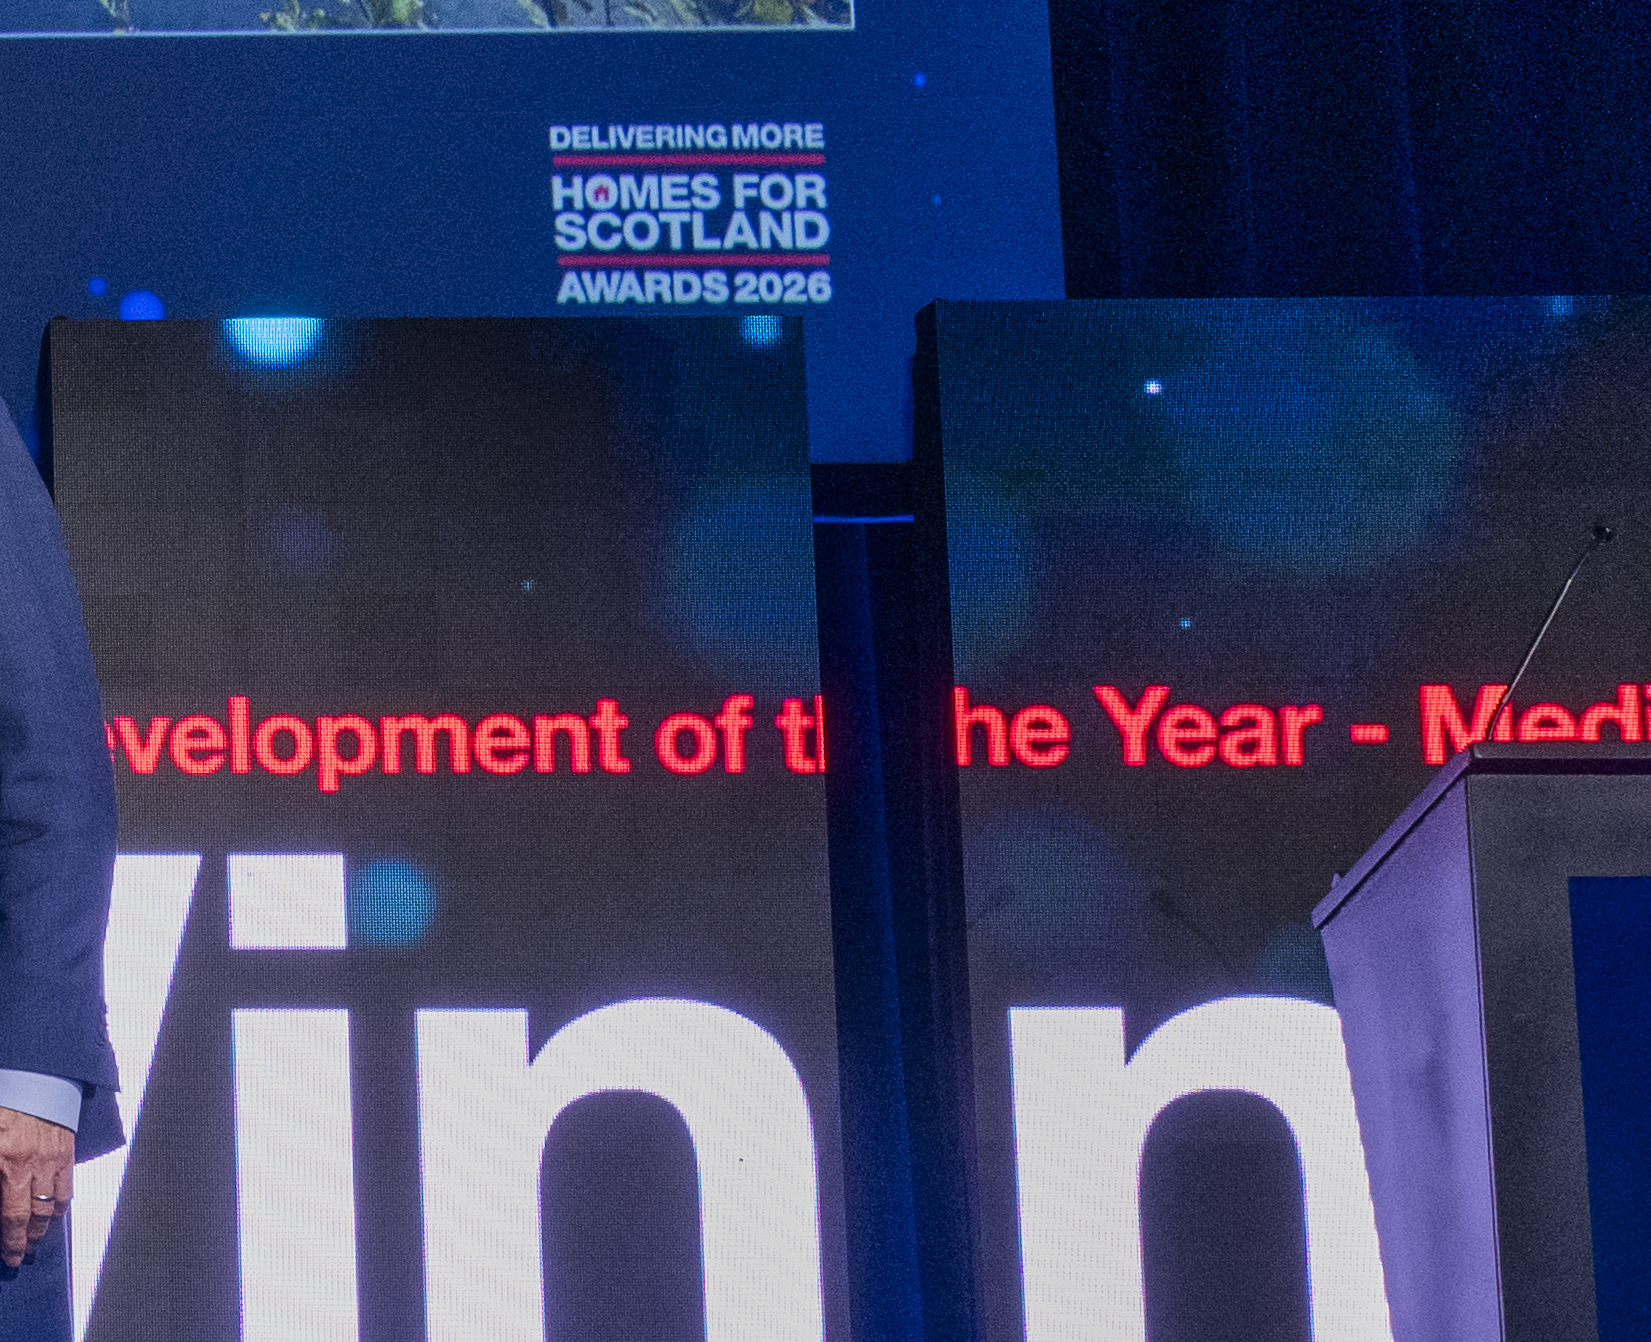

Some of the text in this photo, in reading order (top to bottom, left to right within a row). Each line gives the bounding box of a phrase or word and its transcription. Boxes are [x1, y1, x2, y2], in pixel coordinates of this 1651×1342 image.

[549, 122, 825, 150] DELIVERING MORE
[551, 172, 827, 210] HOMES FOR
[554, 210, 830, 251] SCOTLAND
[557, 270, 832, 304] AWARDS 2026
[104, 694, 632, 793] velopment
[655, 692, 754, 775] of
[1093, 685, 1323, 767] Year
